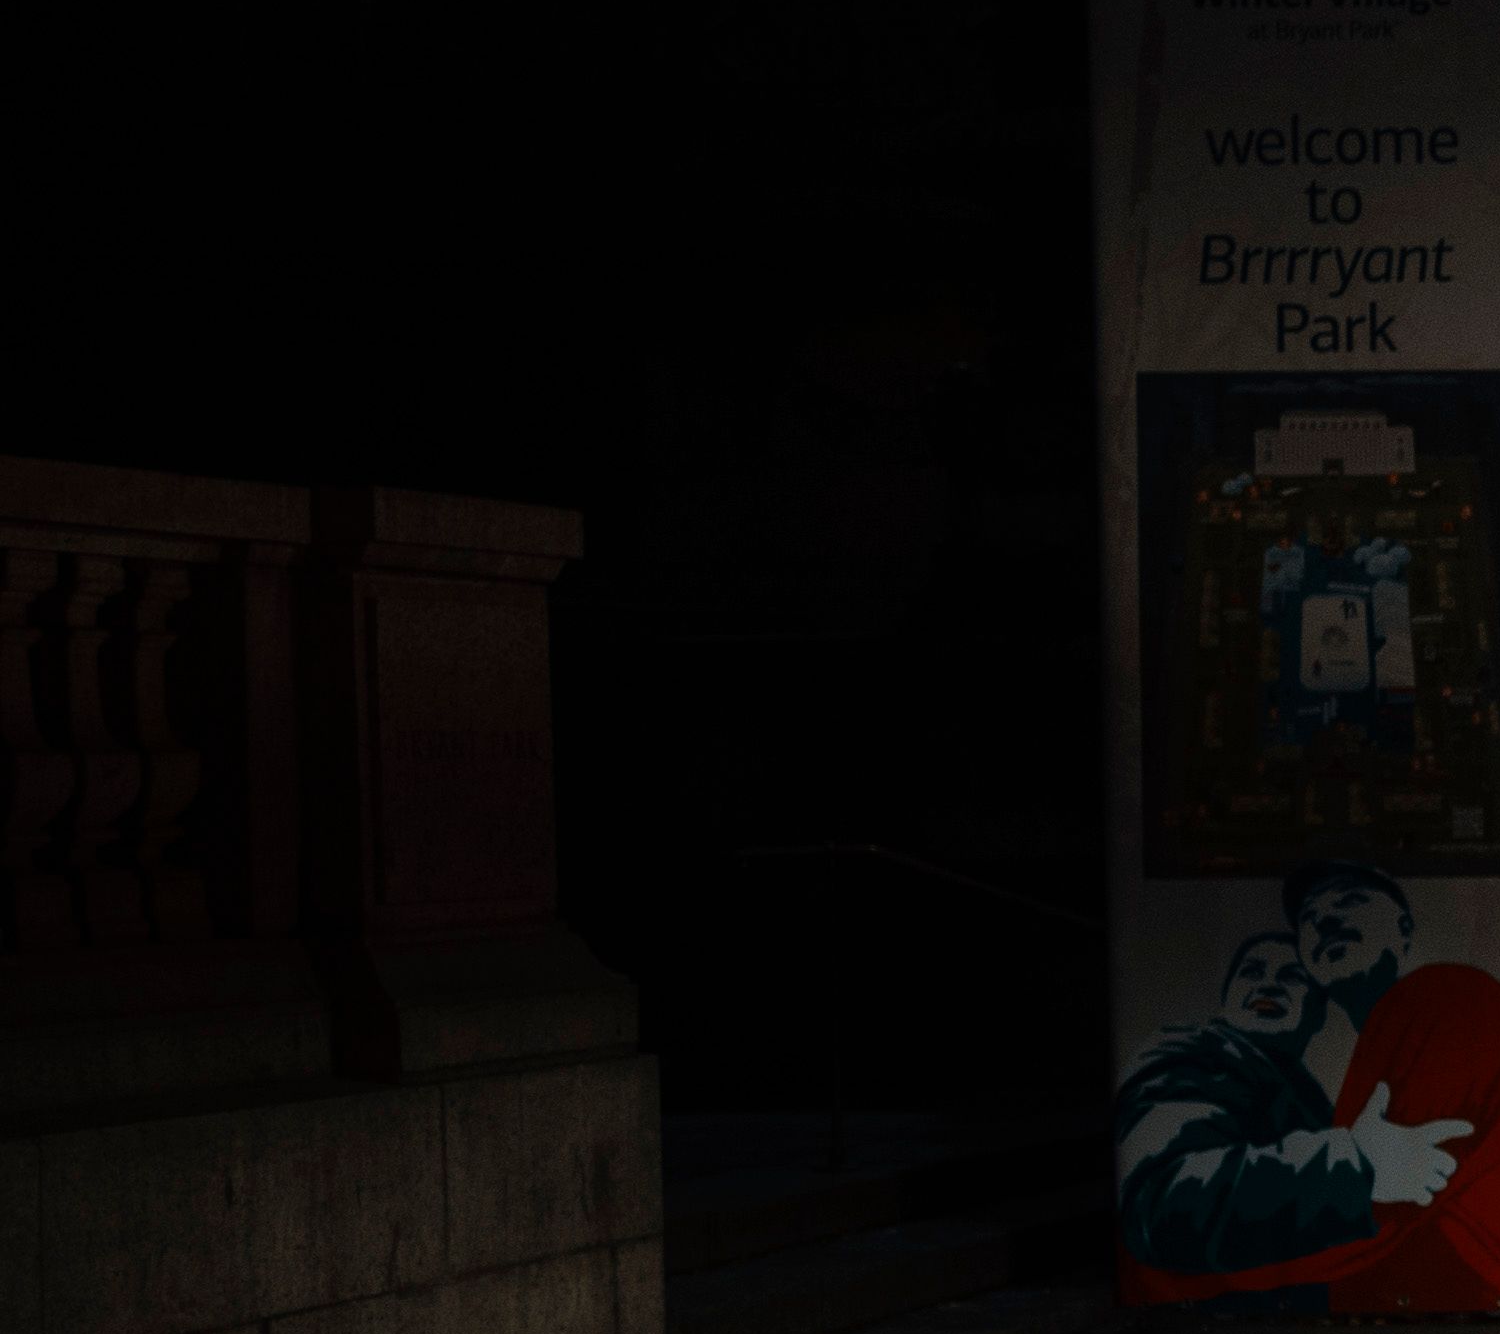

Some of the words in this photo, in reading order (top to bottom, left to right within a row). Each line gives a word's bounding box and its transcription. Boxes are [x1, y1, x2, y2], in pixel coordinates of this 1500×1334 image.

[1205, 115, 1459, 165] welcome
[1305, 180, 1362, 224] to
[1201, 234, 1454, 298] Brrrryant
[1277, 301, 1396, 353] Park
